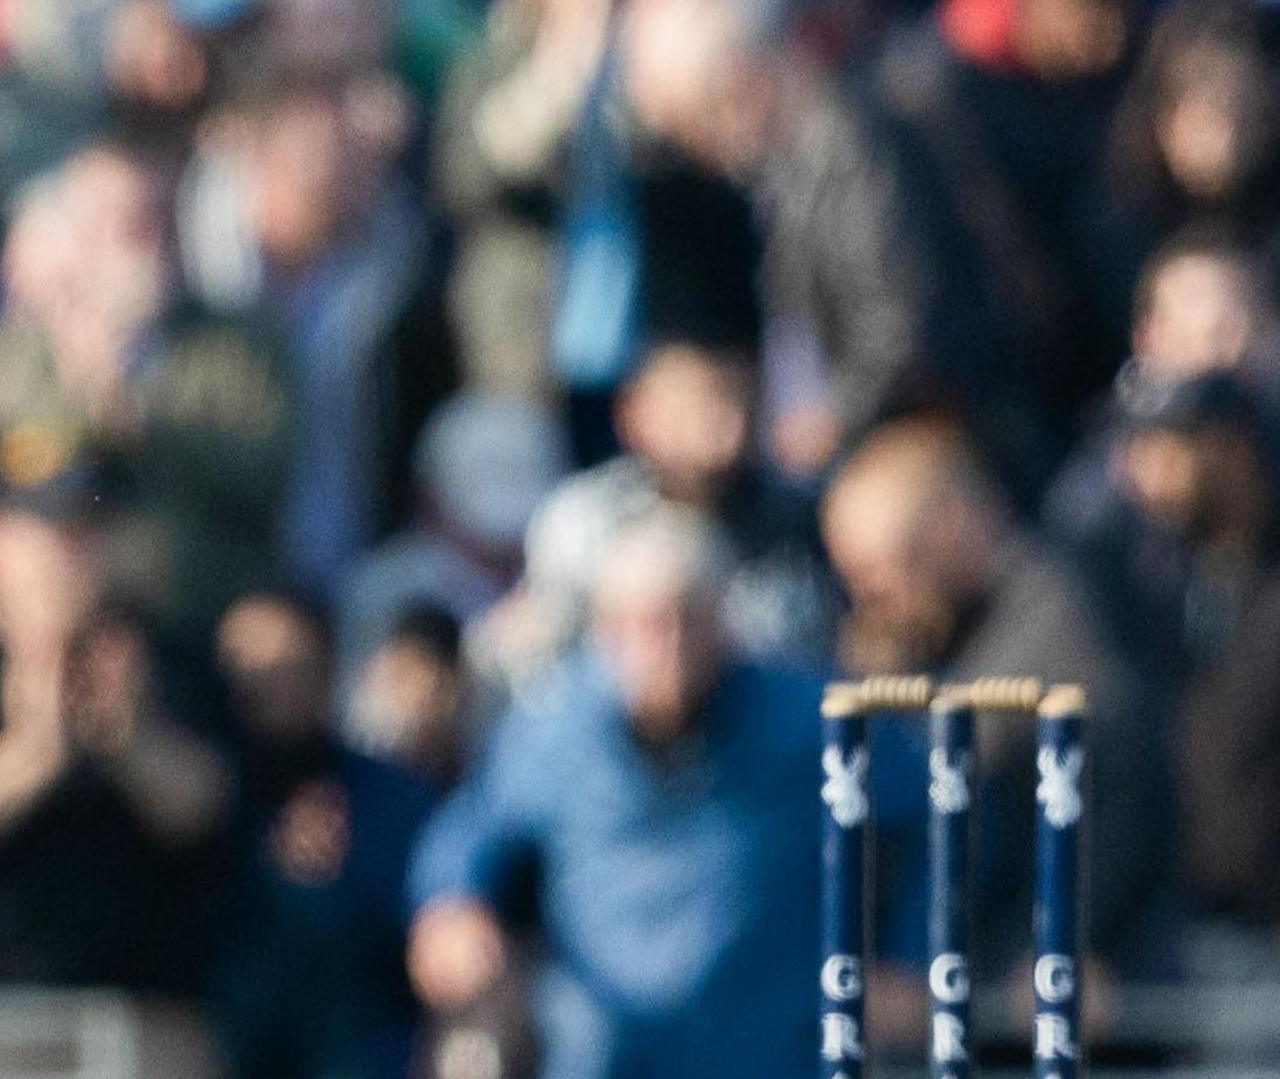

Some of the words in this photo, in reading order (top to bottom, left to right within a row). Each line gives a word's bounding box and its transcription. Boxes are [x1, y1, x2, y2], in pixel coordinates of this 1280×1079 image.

[820, 954, 863, 1079] GR
[929, 953, 970, 1079] GR
[1034, 954, 1076, 1079] GR
